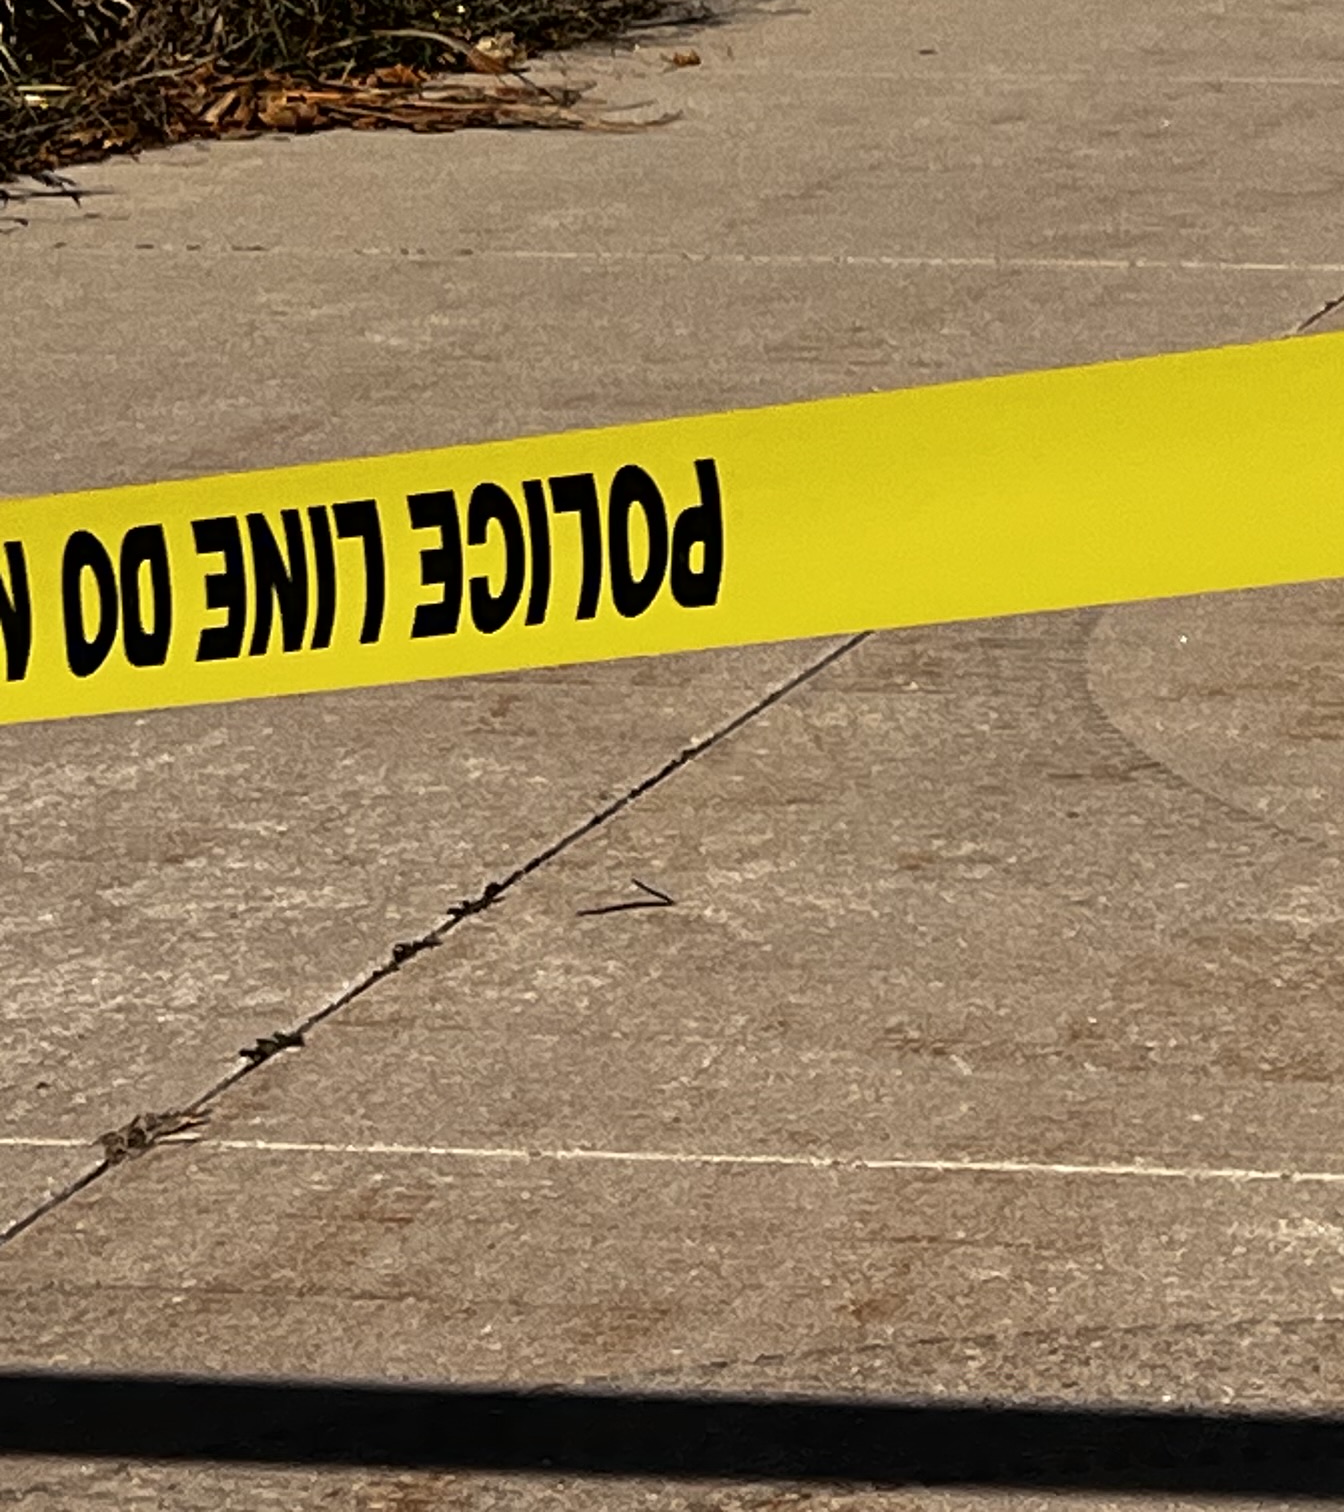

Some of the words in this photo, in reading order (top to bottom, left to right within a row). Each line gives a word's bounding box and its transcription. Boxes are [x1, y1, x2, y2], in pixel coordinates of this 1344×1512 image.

[61, 524, 172, 678] DO
[190, 499, 385, 662] LINE
[406, 458, 723, 639] POLICE
